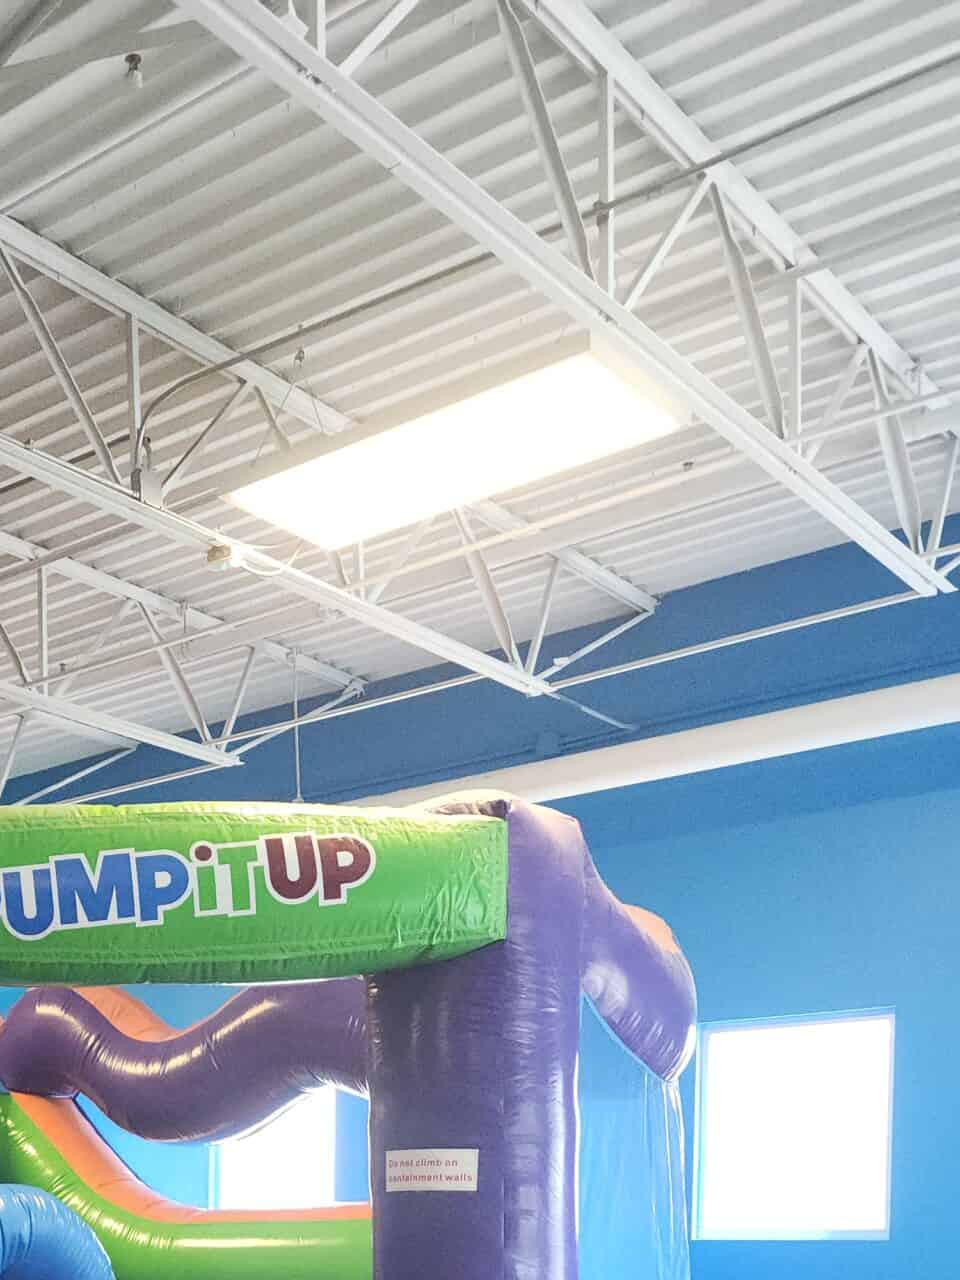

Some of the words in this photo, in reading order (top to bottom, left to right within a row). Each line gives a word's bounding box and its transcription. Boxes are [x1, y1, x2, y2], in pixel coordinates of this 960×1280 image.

[388, 1159, 398, 1168] Do
[400, 1159, 413, 1168] not
[415, 1158, 442, 1168] climb
[444, 1160, 458, 1168] on
[388, 1173, 443, 1182] containment
[445, 1173, 472, 1182] walls
